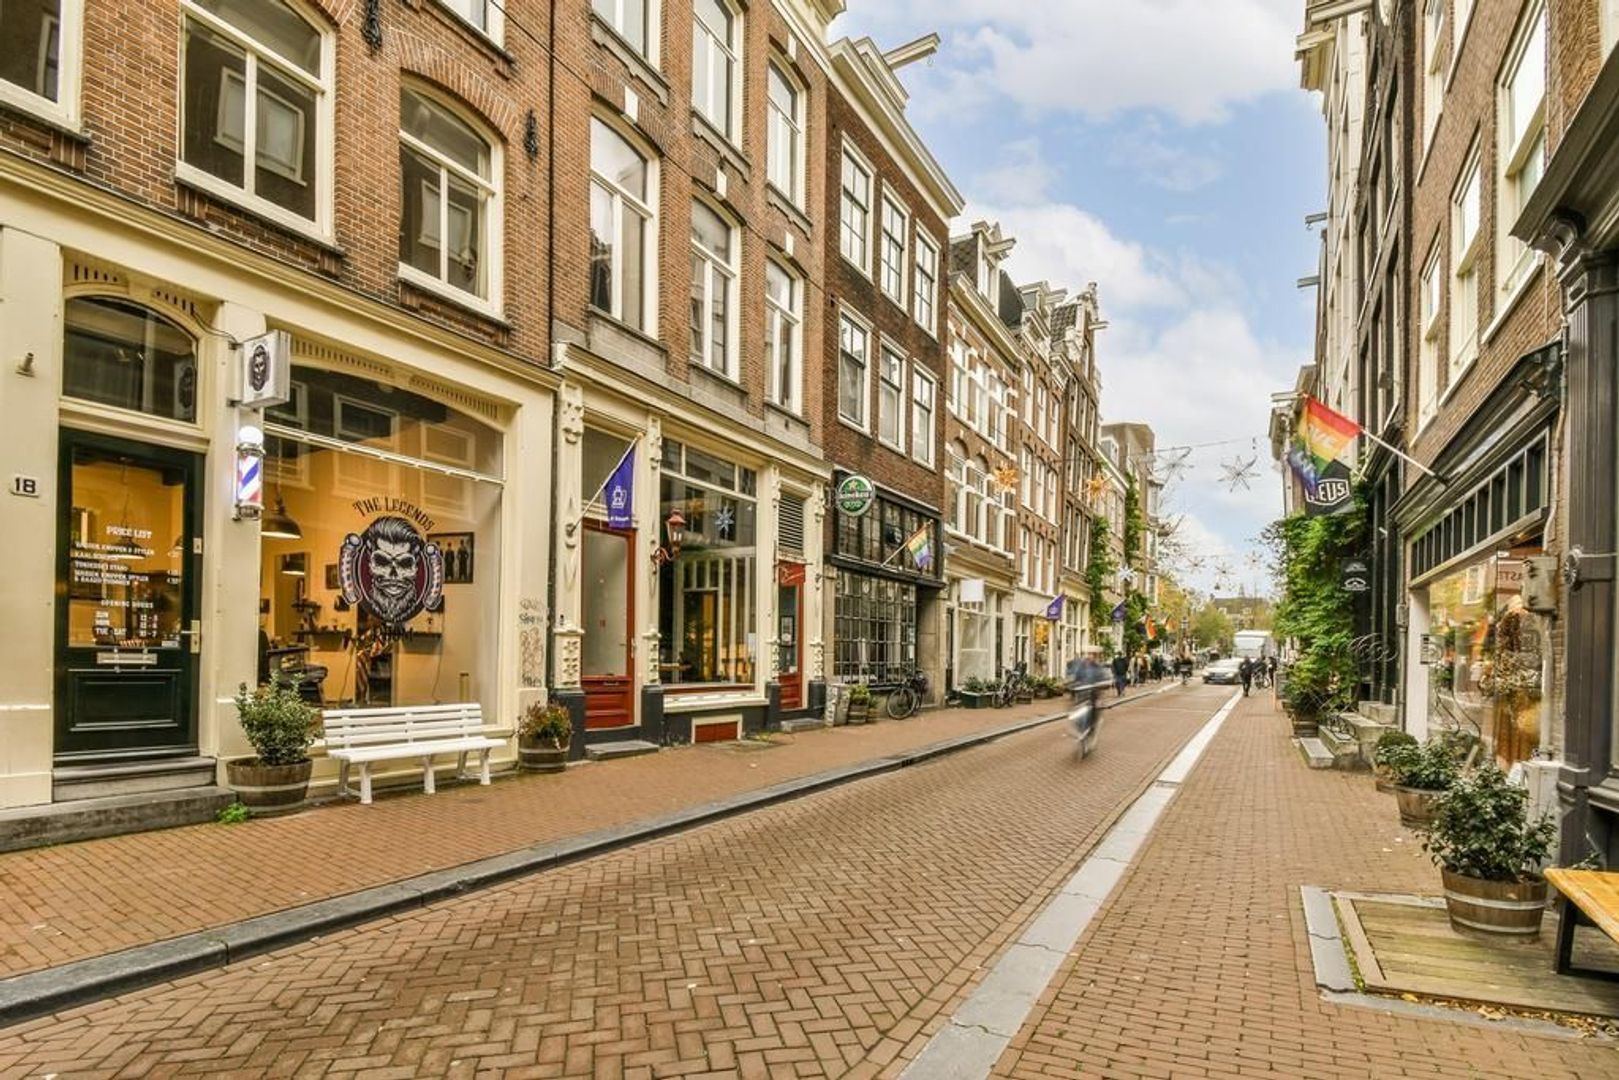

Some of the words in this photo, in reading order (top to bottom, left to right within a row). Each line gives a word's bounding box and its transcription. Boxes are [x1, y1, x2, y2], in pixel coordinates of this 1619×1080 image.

[15, 477, 36, 494] 18
[1309, 481, 1345, 502] EUS
[352, 497, 382, 517] THE
[106, 526, 132, 536] PRICE
[134, 528, 152, 538] LIST
